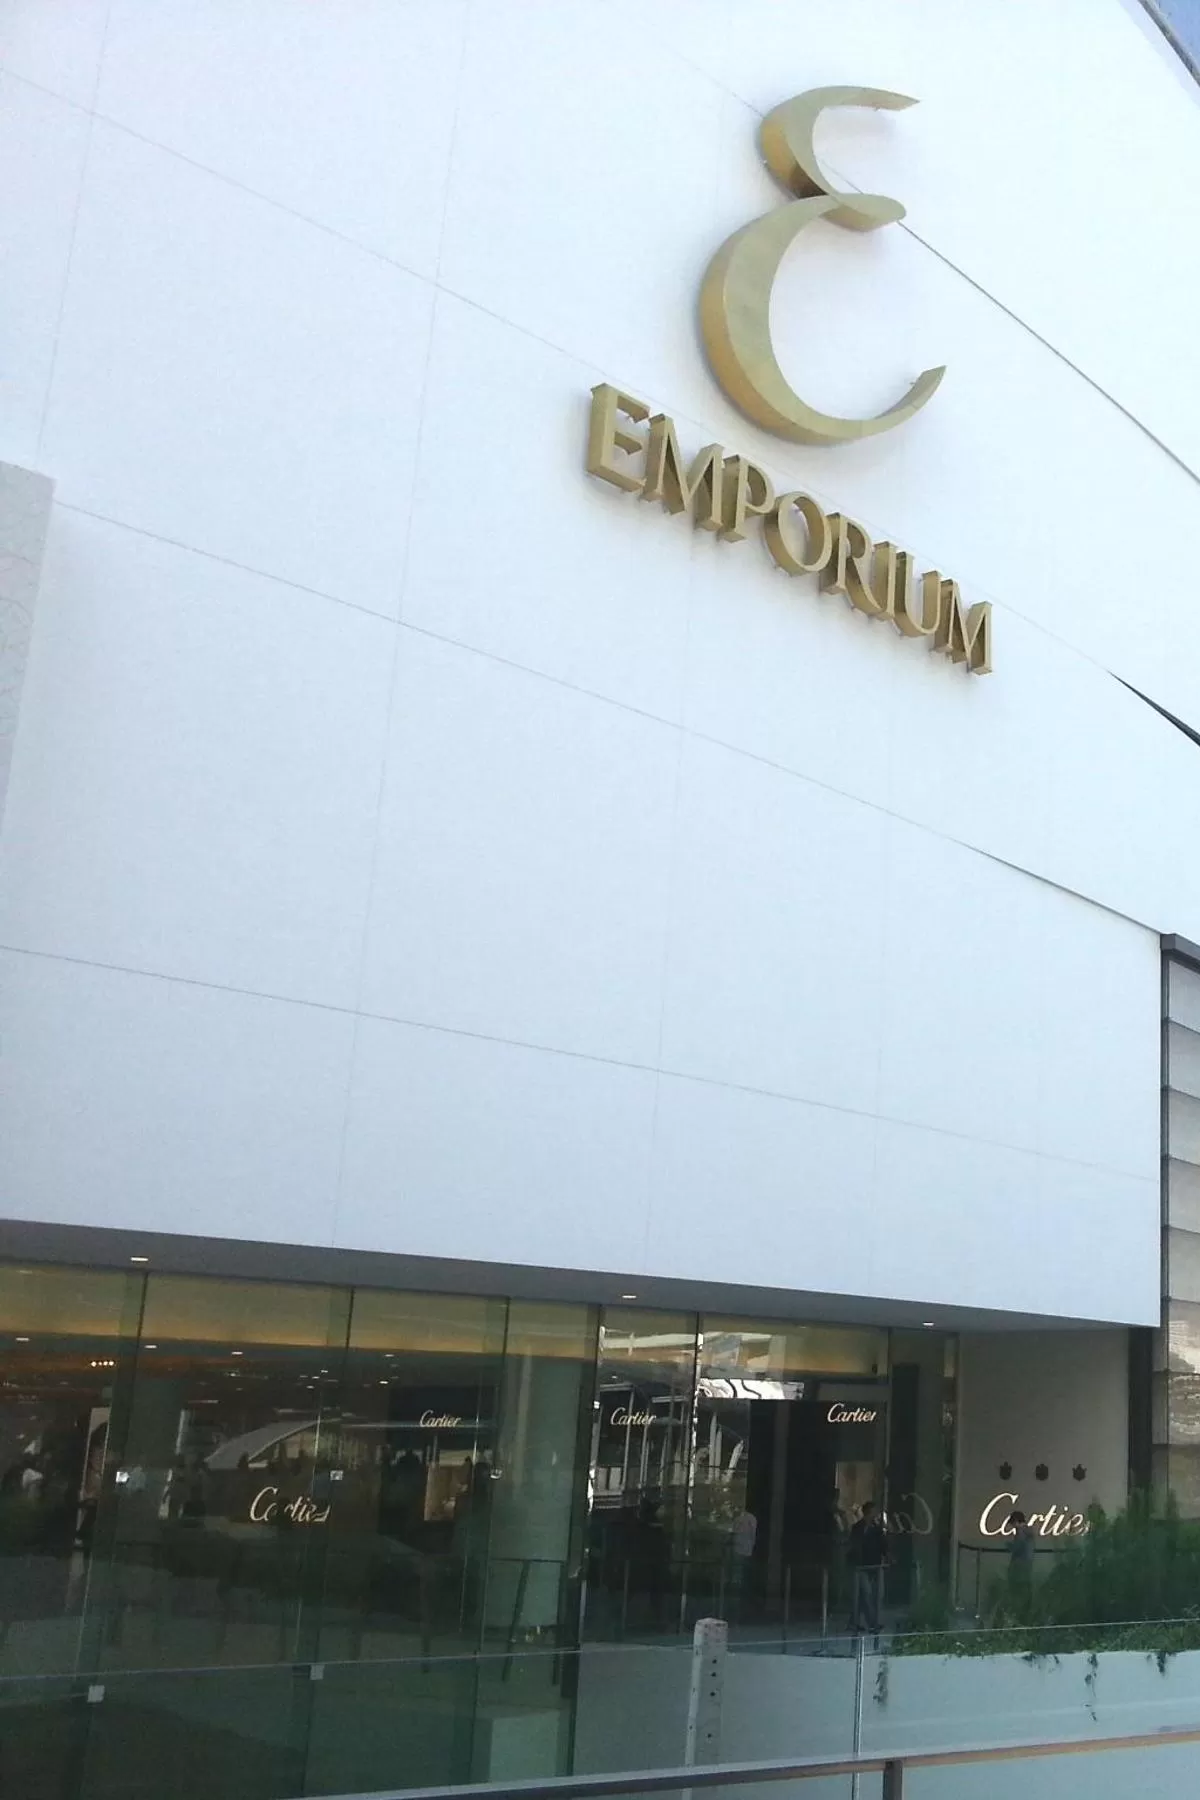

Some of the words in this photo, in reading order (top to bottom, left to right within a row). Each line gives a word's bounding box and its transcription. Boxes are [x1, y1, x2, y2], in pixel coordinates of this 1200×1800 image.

[584, 382, 994, 676] EMPORIUM
[419, 1409, 462, 1428] Cartier
[609, 1407, 657, 1426] Cartier
[827, 1402, 877, 1423] Cartier
